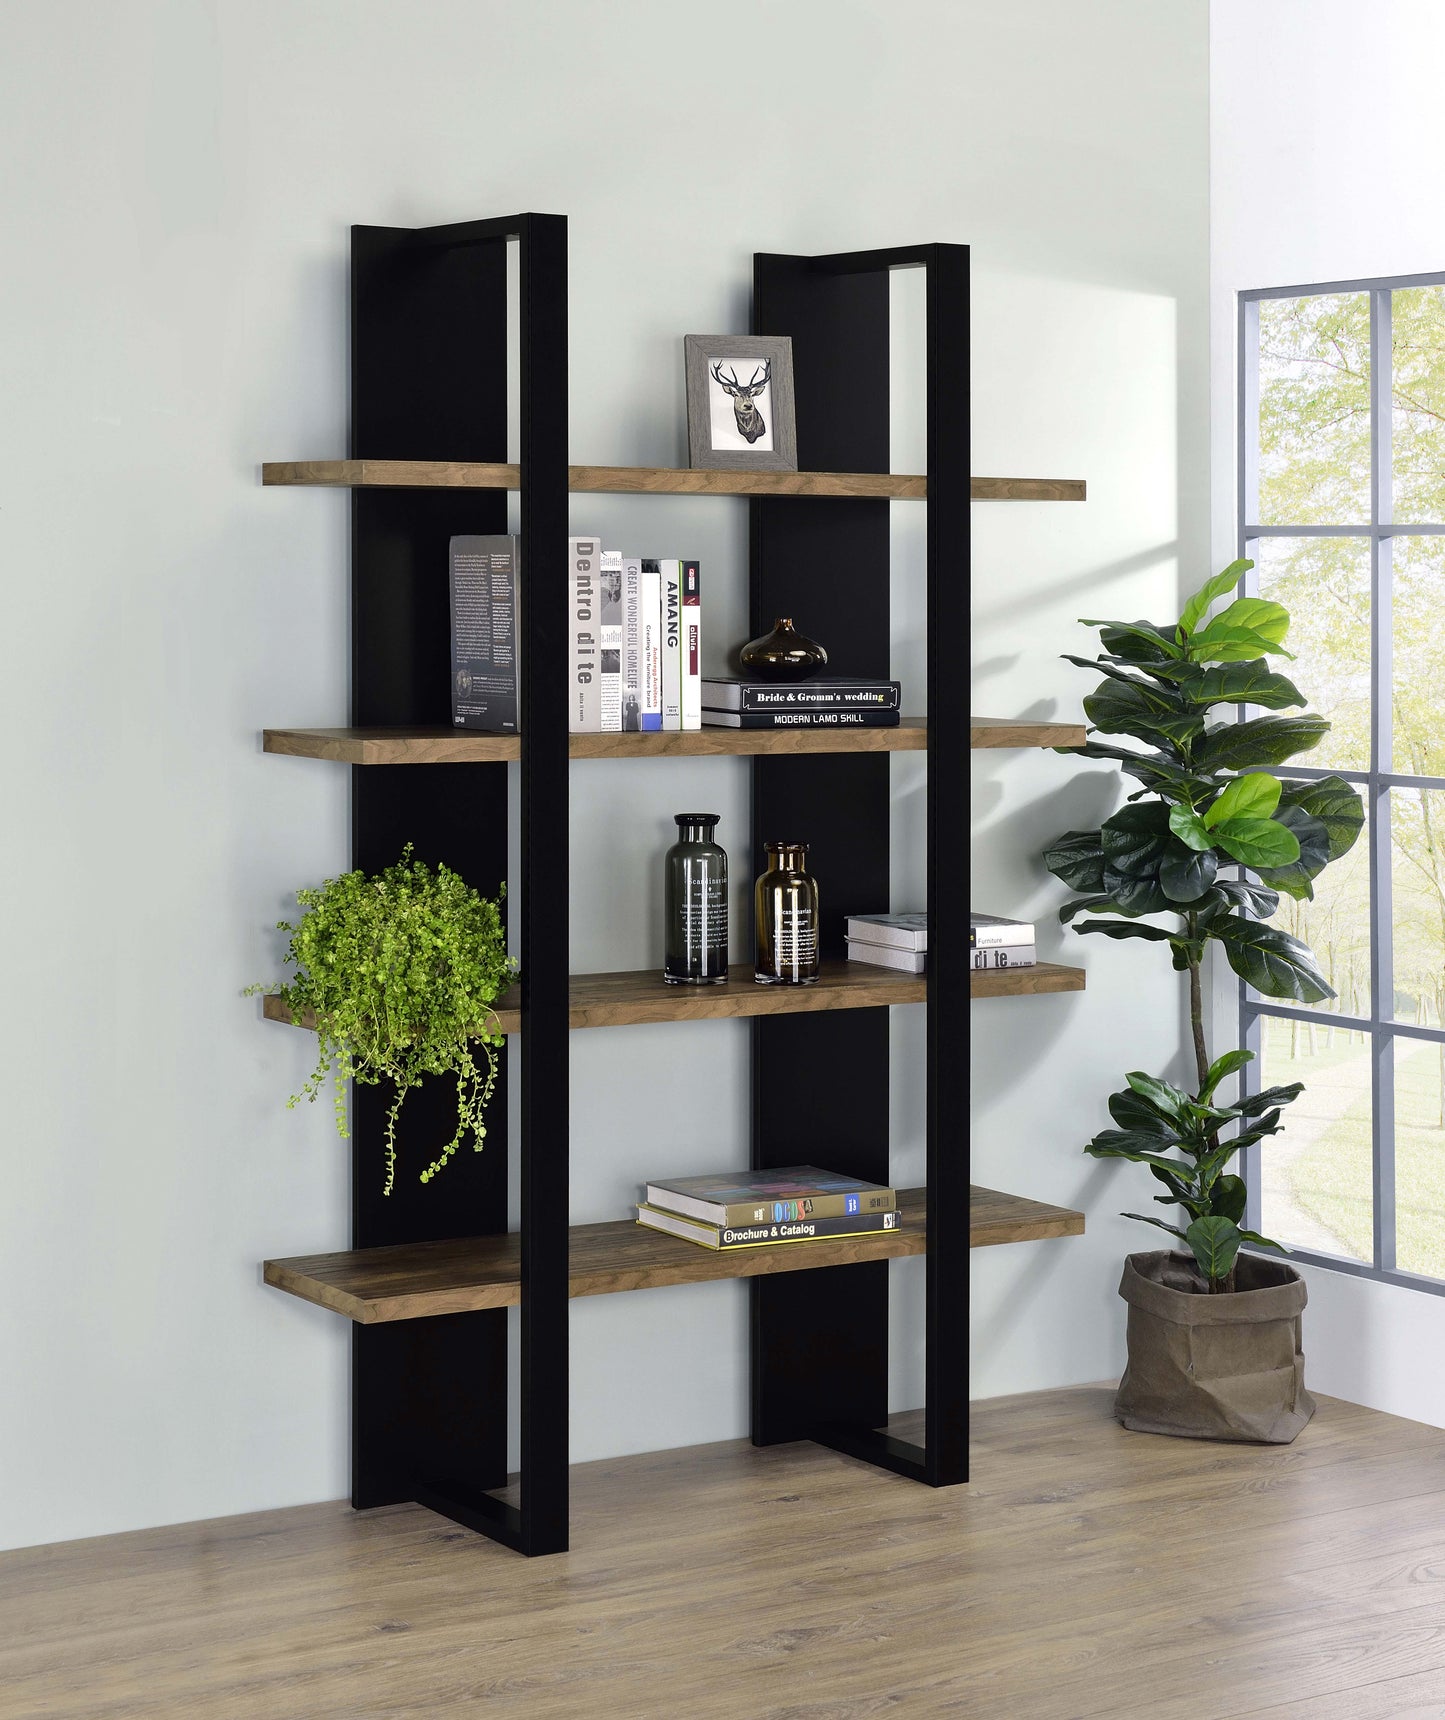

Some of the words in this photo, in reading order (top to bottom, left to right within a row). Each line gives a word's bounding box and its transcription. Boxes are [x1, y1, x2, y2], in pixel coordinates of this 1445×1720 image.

[576, 542, 594, 621] Dentro
[627, 565, 638, 594] CREATE
[627, 597, 638, 647] WONDERFUL
[667, 581, 678, 648] AMANG
[577, 632, 595, 655] di
[577, 662, 595, 684] te
[627, 649, 638, 689] HOMELIFE
[757, 693, 785, 702] Bride
[786, 693, 796, 702] &
[797, 692, 841, 702] Gromm's
[844, 692, 884, 703] wedding
[774, 715, 811, 724] MODERN
[840, 713, 864, 723] SKILL
[977, 937, 1003, 945] Furniture
[974, 950, 988, 969] di
[994, 950, 1008, 968] te
[723, 1226, 769, 1243] Brochure
[770, 1227, 778, 1237] &
[780, 1224, 815, 1239] Catalog
